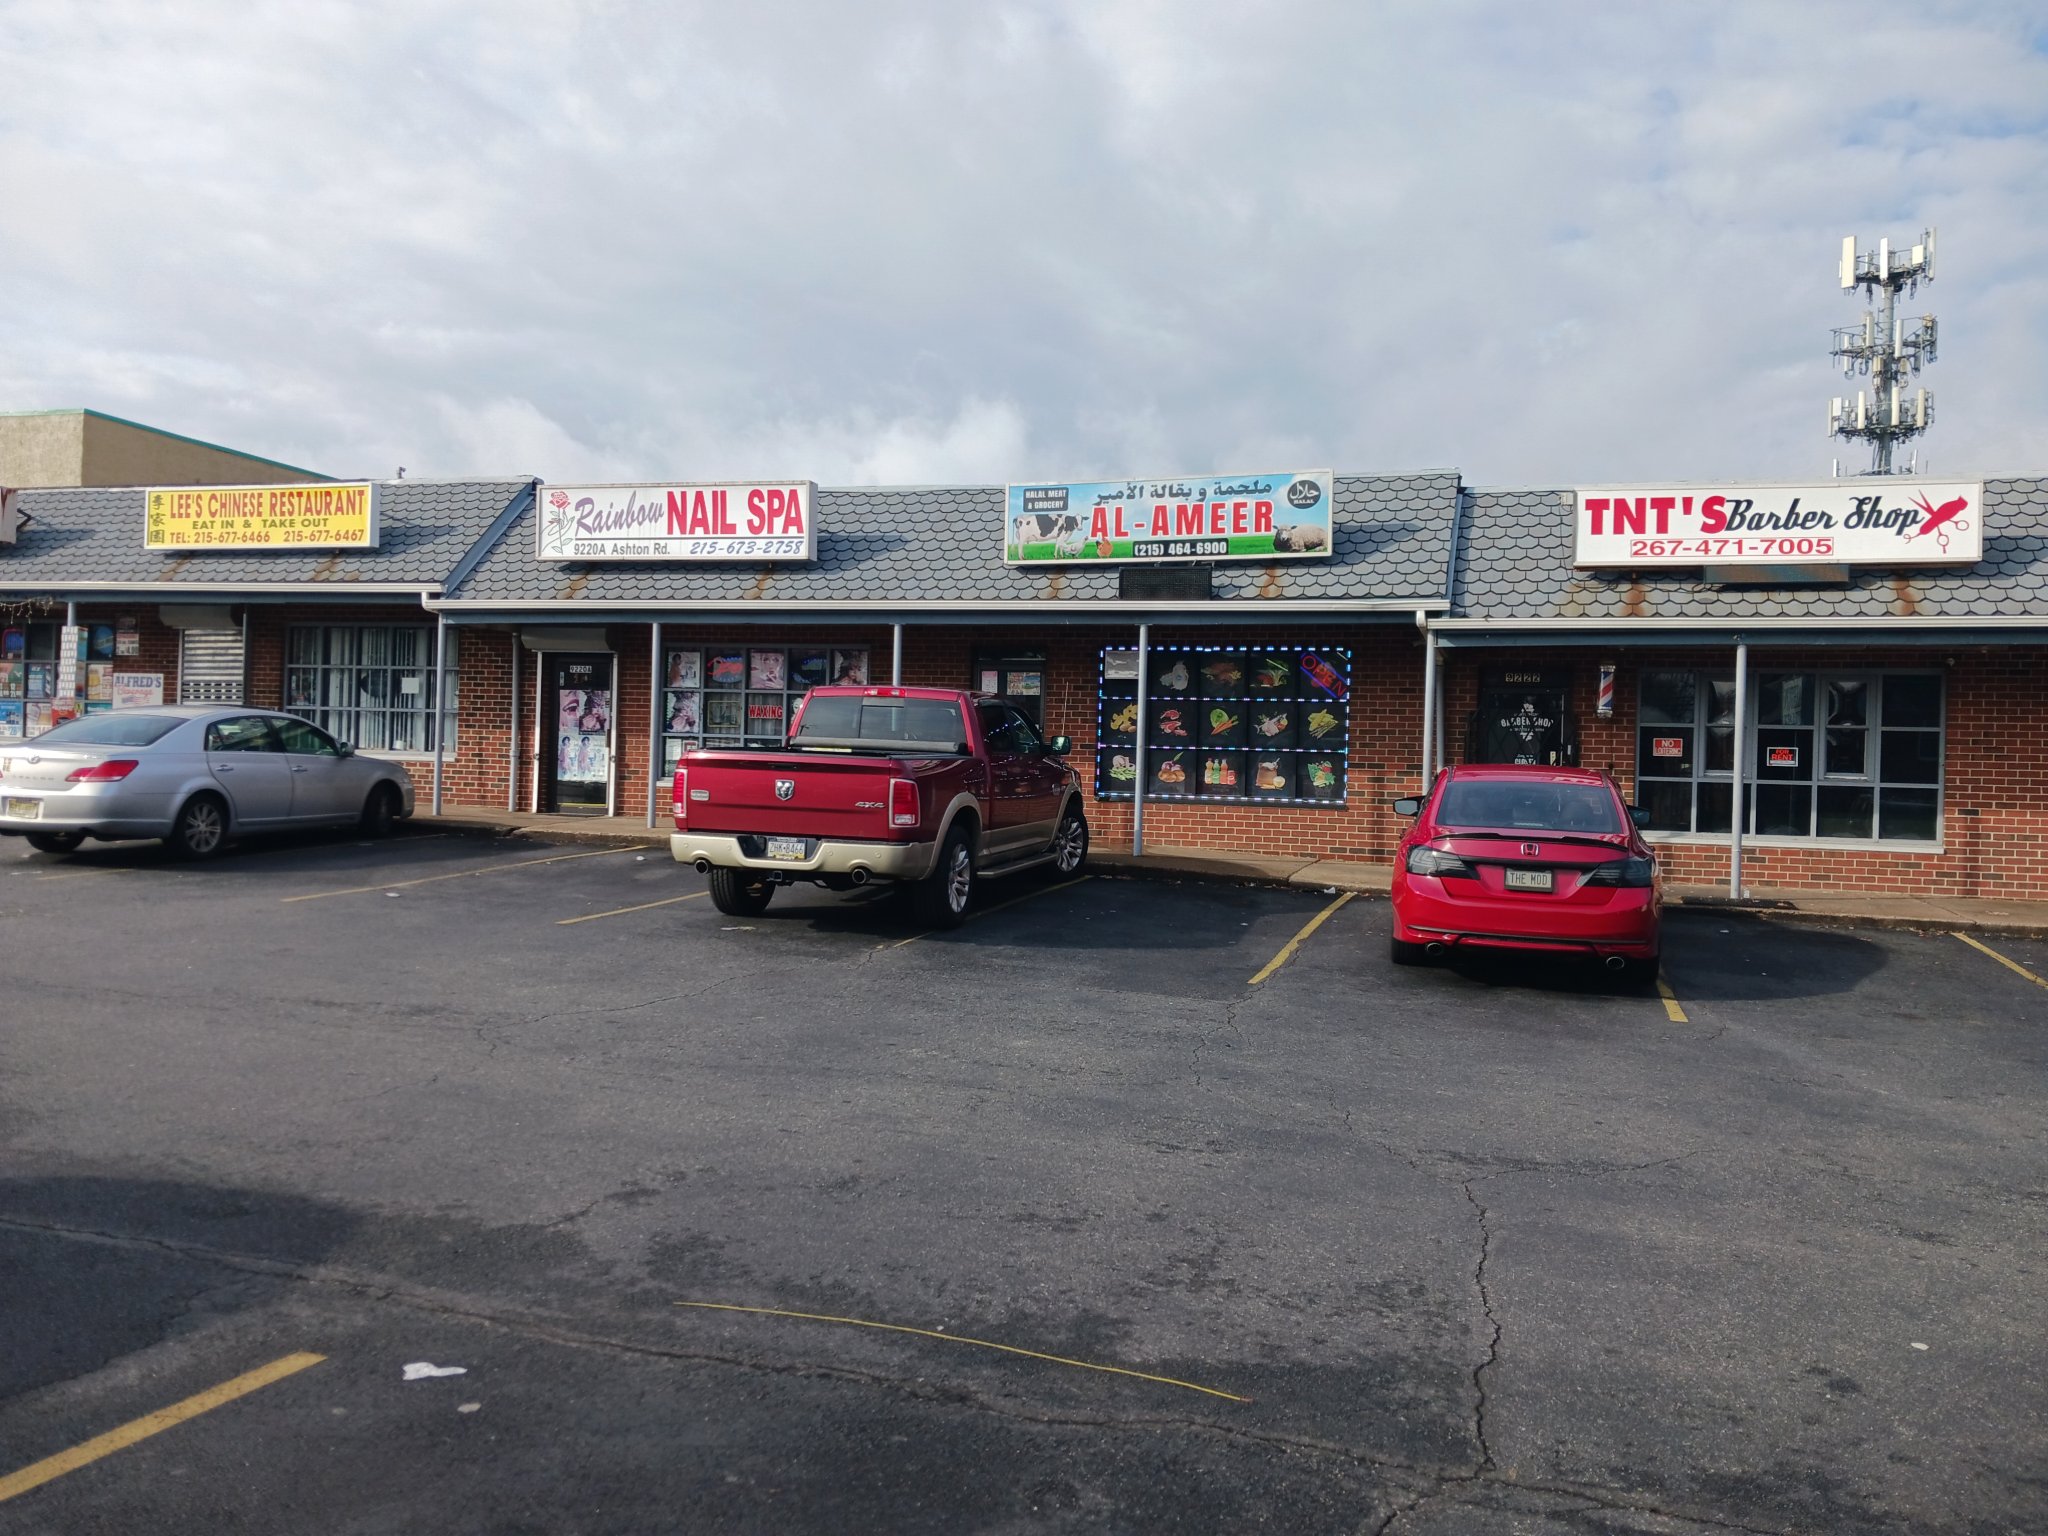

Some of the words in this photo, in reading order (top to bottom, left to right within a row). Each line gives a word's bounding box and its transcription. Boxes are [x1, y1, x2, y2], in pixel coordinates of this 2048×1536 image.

[1025, 490, 1047, 499] HALAL
[1047, 489, 1067, 498] MEAT
[1213, 480, 1273, 497] ملحمة
[1289, 482, 1320, 499] حلال
[170, 493, 203, 518] LEE'S
[208, 492, 263, 518] CHINESE
[269, 490, 365, 518] RESTAURANT
[1034, 500, 1064, 509] GROCERY
[574, 490, 665, 538] Rainbow
[667, 490, 736, 535] NAIL
[746, 488, 804, 535] SPA
[1585, 495, 1727, 535] TNT'S
[1724, 497, 1838, 532] Barber
[1844, 496, 1925, 536] Shop
[192, 520, 216, 530] EAT
[221, 520, 234, 529] IN
[243, 519, 252, 529] &
[261, 518, 296, 529] TAKE
[301, 518, 329, 528] OUT
[170, 532, 190, 544] TEL:
[194, 530, 271, 544] 215-677-6466
[283, 529, 365, 543] 215-677-6467
[574, 543, 607, 556] 9220A
[611, 543, 648, 556] Ashton
[653, 542, 671, 555] Rd.
[690, 540, 804, 555] 215-673-2758
[1133, 542, 1165, 557] (215)
[1168, 540, 1228, 556] 464-6900
[1631, 538, 1833, 557] 267-471-7005
[1301, 654, 1348, 698] OPEN
[748, 704, 783, 719] WAXING
[1661, 740, 1675, 748] NO
[1510, 872, 1526, 885] THE
[1530, 873, 1548, 886] MOD
